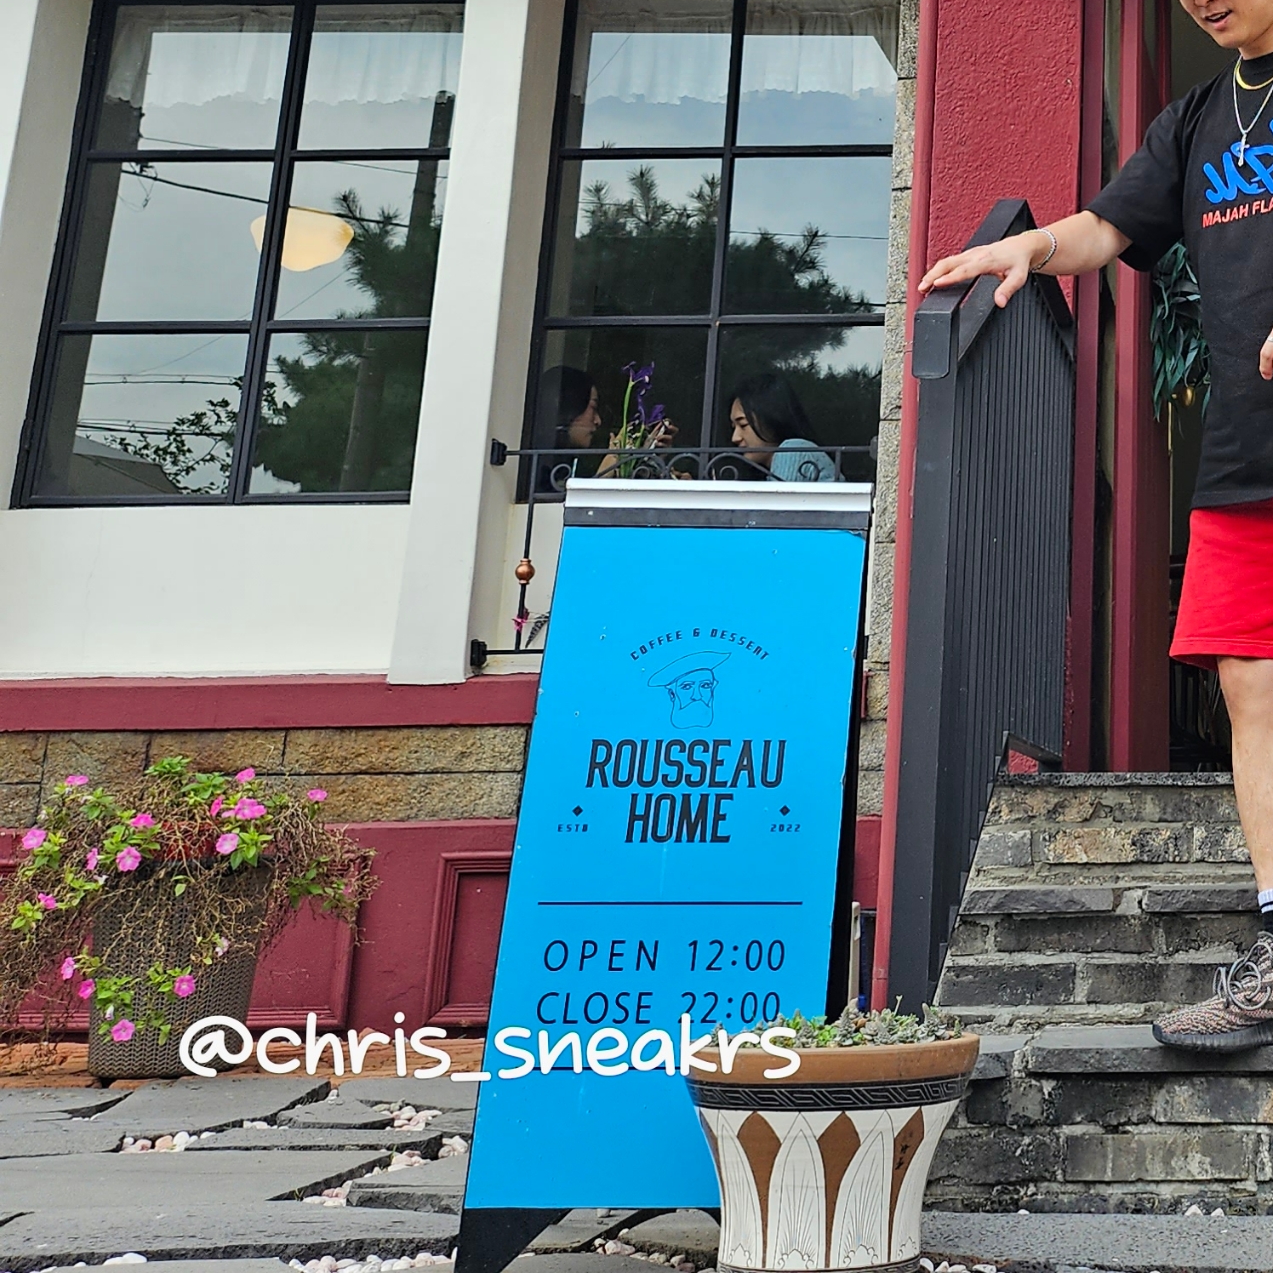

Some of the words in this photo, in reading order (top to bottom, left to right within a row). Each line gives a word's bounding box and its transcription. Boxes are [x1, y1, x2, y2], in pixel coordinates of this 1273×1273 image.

[1202, 204, 1249, 228] MAJAH
[630, 630, 683, 661] COFFEE
[710, 628, 770, 660] DESSERT
[585, 739, 787, 788] ROUSSEAU
[624, 793, 734, 843] HOME
[770, 823, 801, 833] 2022
[543, 939, 659, 971] OPEN
[688, 939, 785, 971] 12:00
[536, 991, 654, 1024] CLOSE
[678, 991, 781, 1024] 22:00
